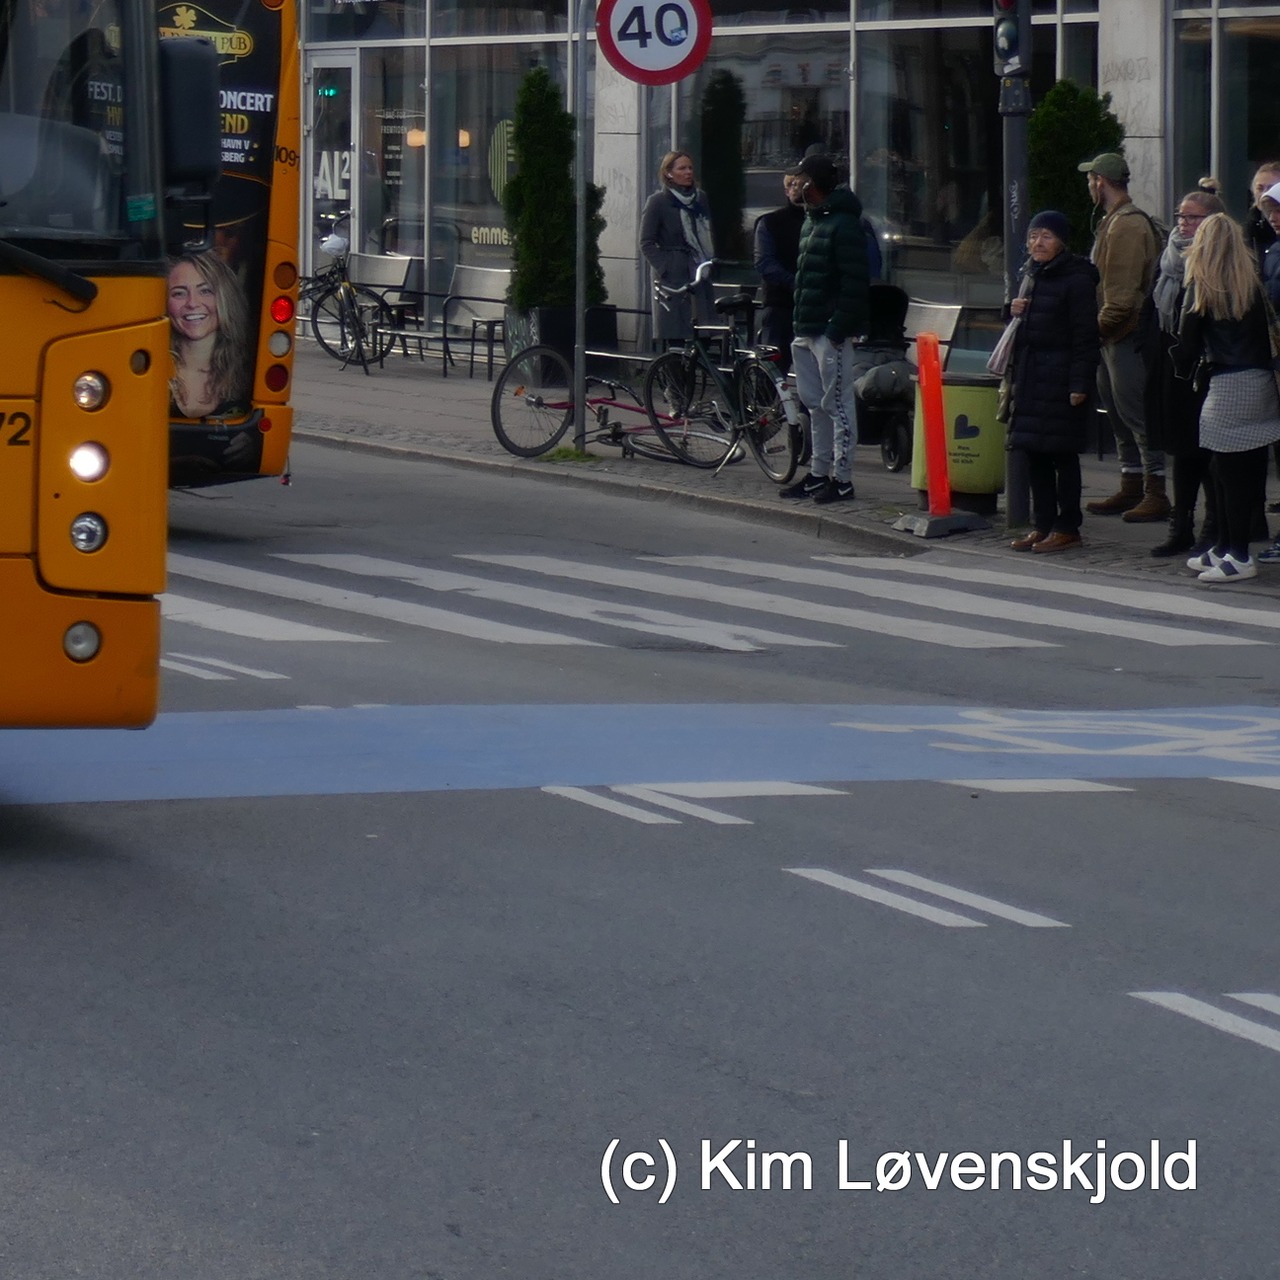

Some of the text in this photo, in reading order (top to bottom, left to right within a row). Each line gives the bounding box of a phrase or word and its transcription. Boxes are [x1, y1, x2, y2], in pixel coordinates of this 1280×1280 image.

[617, 2, 689, 49] 40
[221, 36, 247, 51] PUB
[88, 80, 116, 103] FEST.
[243, 139, 250, 150] V
